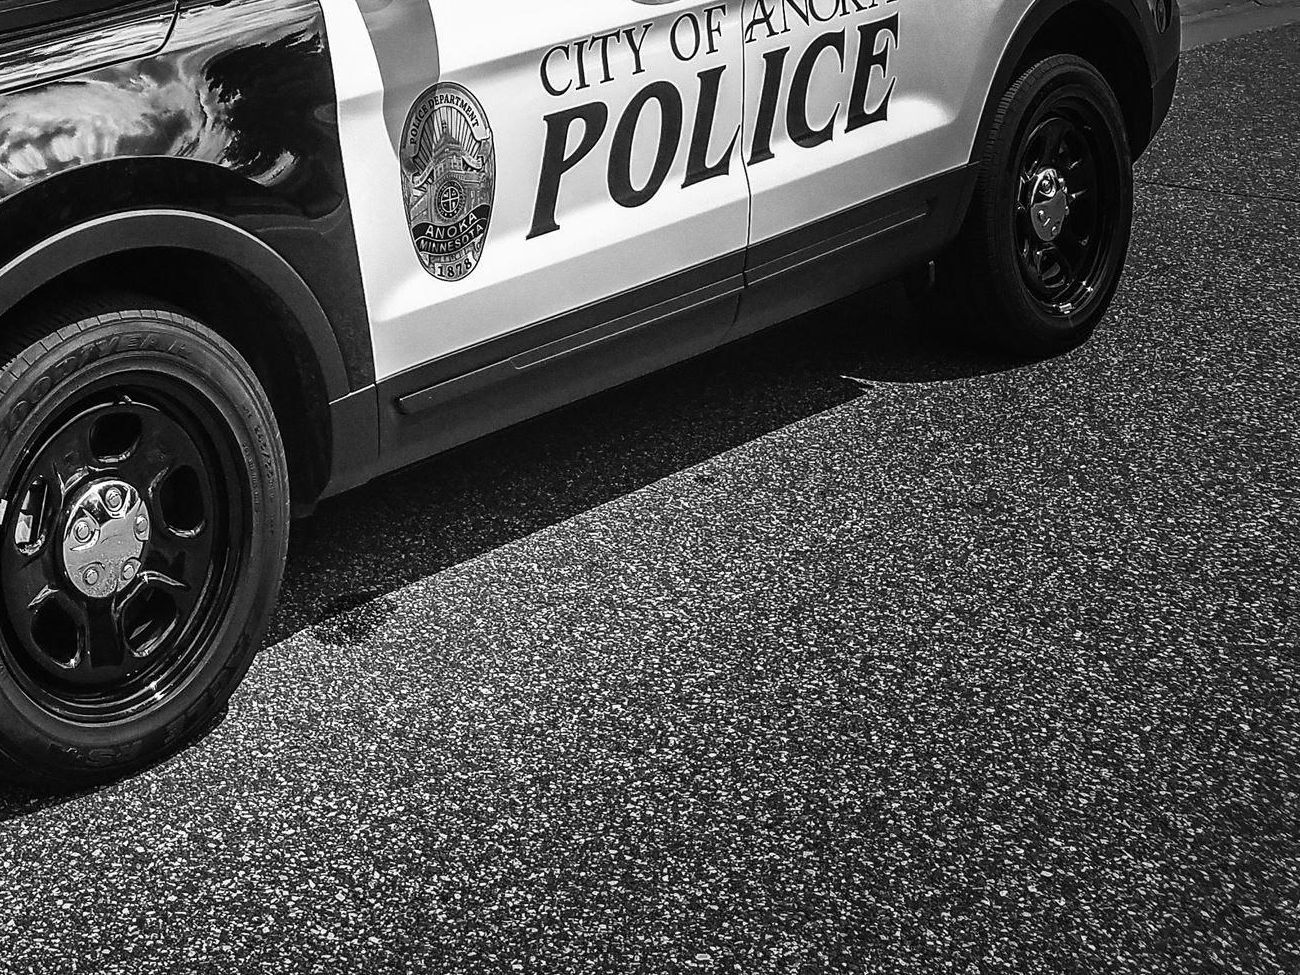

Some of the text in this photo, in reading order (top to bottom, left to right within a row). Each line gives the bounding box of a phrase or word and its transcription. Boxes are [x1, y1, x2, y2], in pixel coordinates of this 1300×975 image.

[539, 22, 653, 96] CITY
[669, 4, 727, 61] OF
[409, 94, 480, 145] POLICE DEPARTMENT
[525, 12, 900, 240] POLICE
[419, 224, 484, 253] MINNESOTA
[425, 213, 477, 238] ANOKA
[437, 258, 473, 278] 1878
